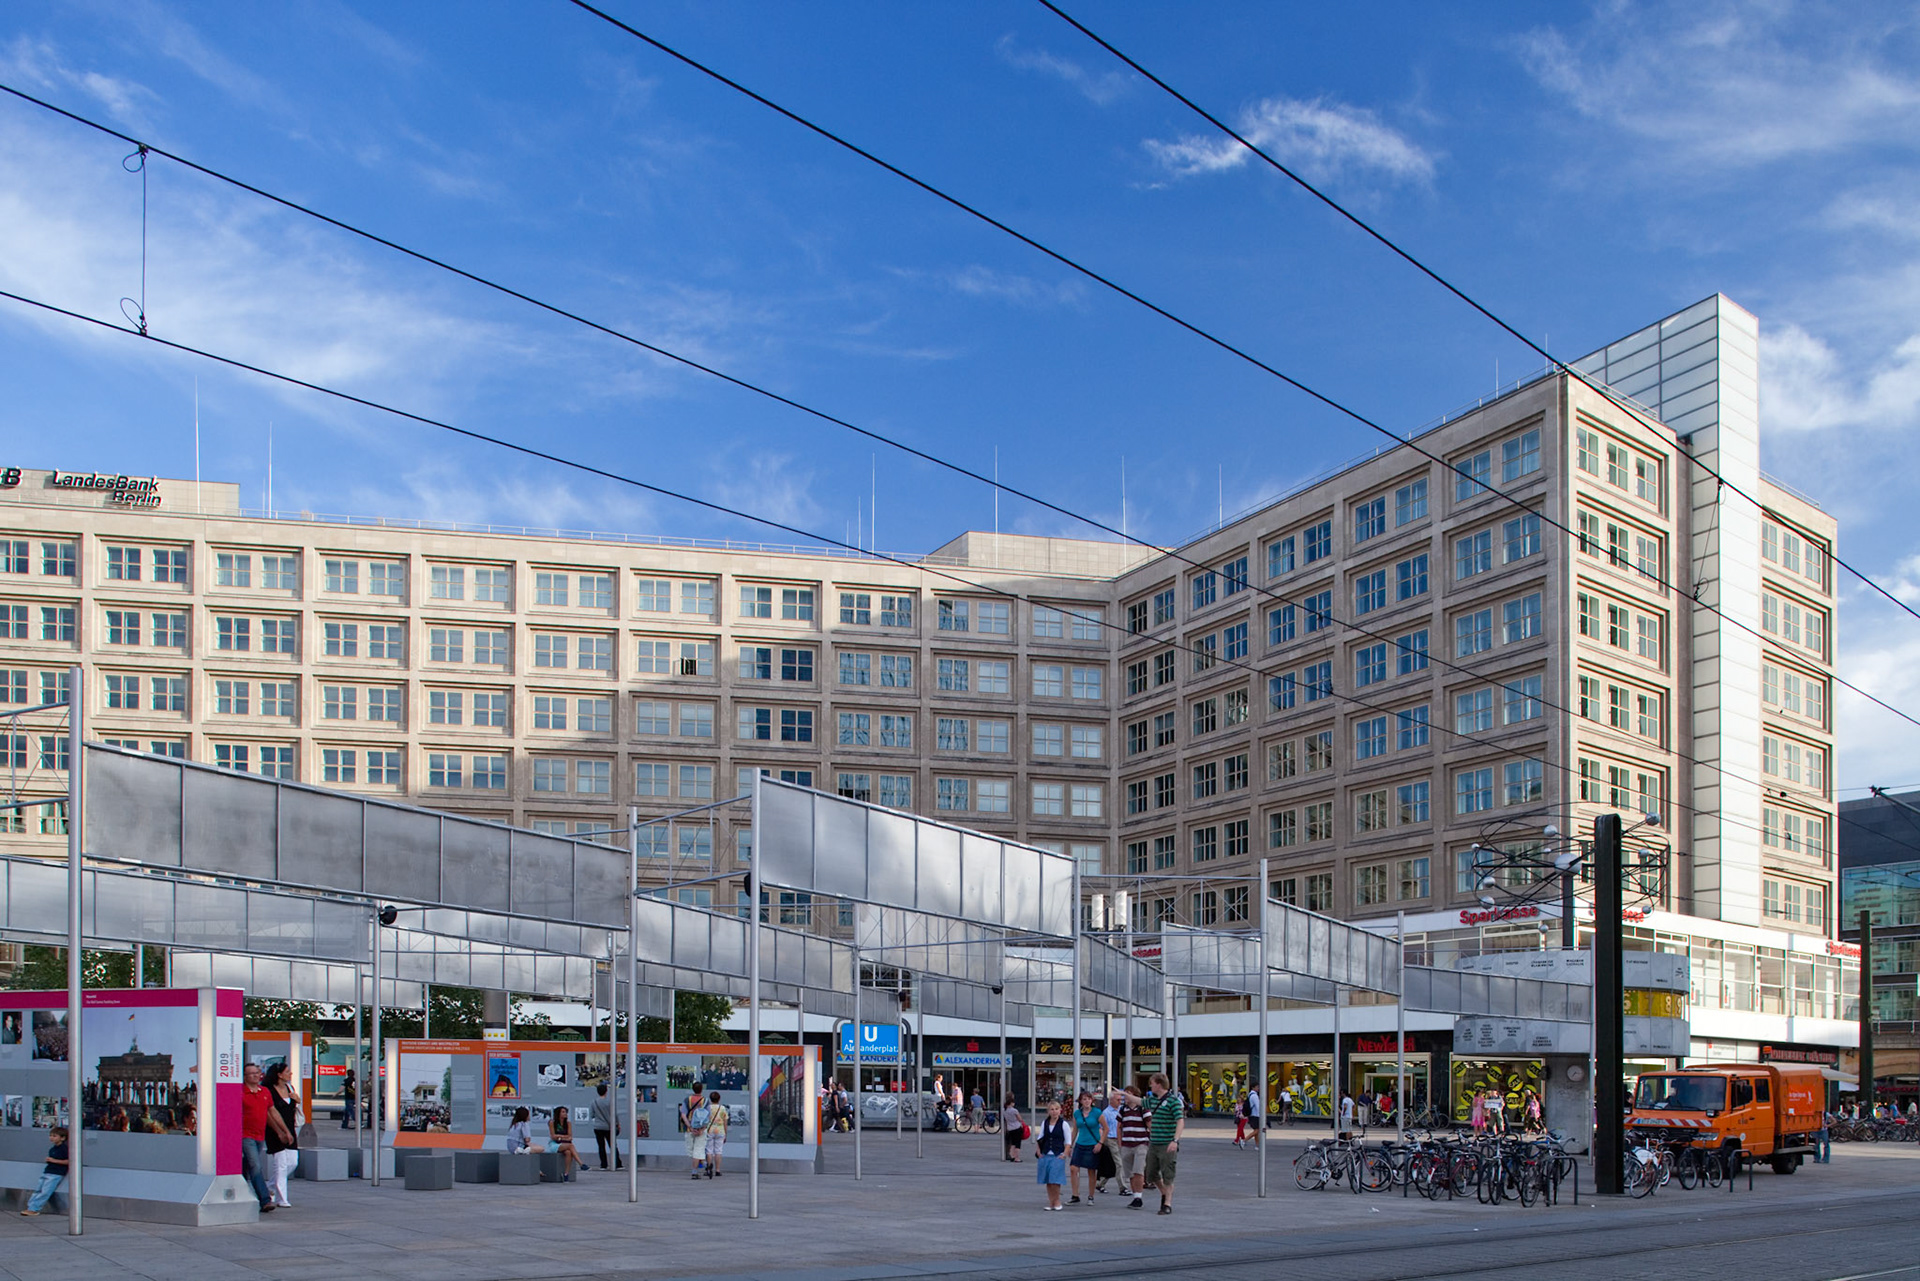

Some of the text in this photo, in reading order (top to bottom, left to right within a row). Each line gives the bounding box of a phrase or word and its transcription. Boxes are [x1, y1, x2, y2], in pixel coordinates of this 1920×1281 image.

[52, 470, 159, 492] LandesBank
[112, 490, 162, 507] Berlin
[864, 1026, 878, 1042] U
[220, 1053, 229, 1077] 2009
[944, 1056, 1011, 1065] ALEXANDERHAS
